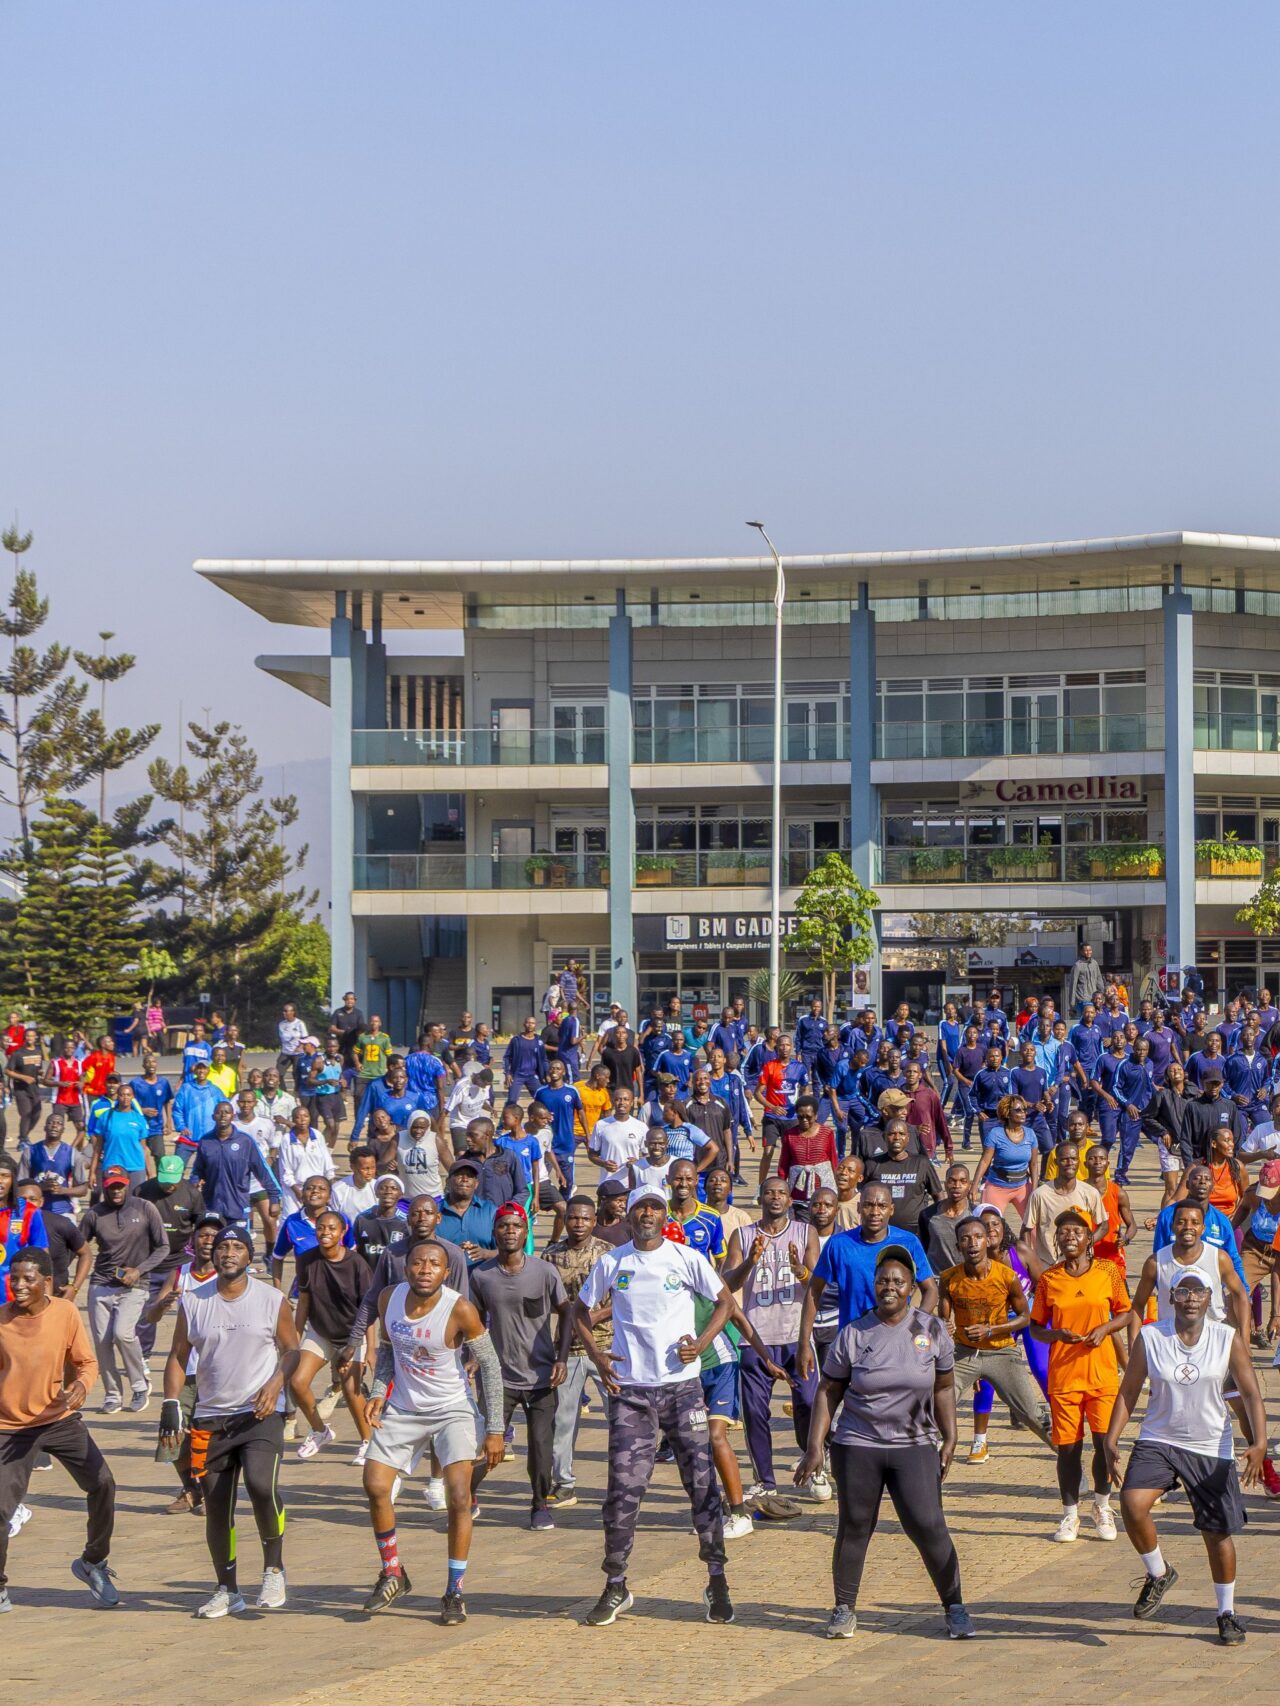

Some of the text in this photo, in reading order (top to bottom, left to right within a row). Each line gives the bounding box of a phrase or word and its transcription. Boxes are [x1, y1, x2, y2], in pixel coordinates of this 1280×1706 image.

[995, 775, 1139, 802] Camellia
[698, 917, 727, 937] BM
[365, 1044, 380, 1062] 12
[757, 1266, 795, 1307] 33
[696, 1409, 708, 1424] NBA
